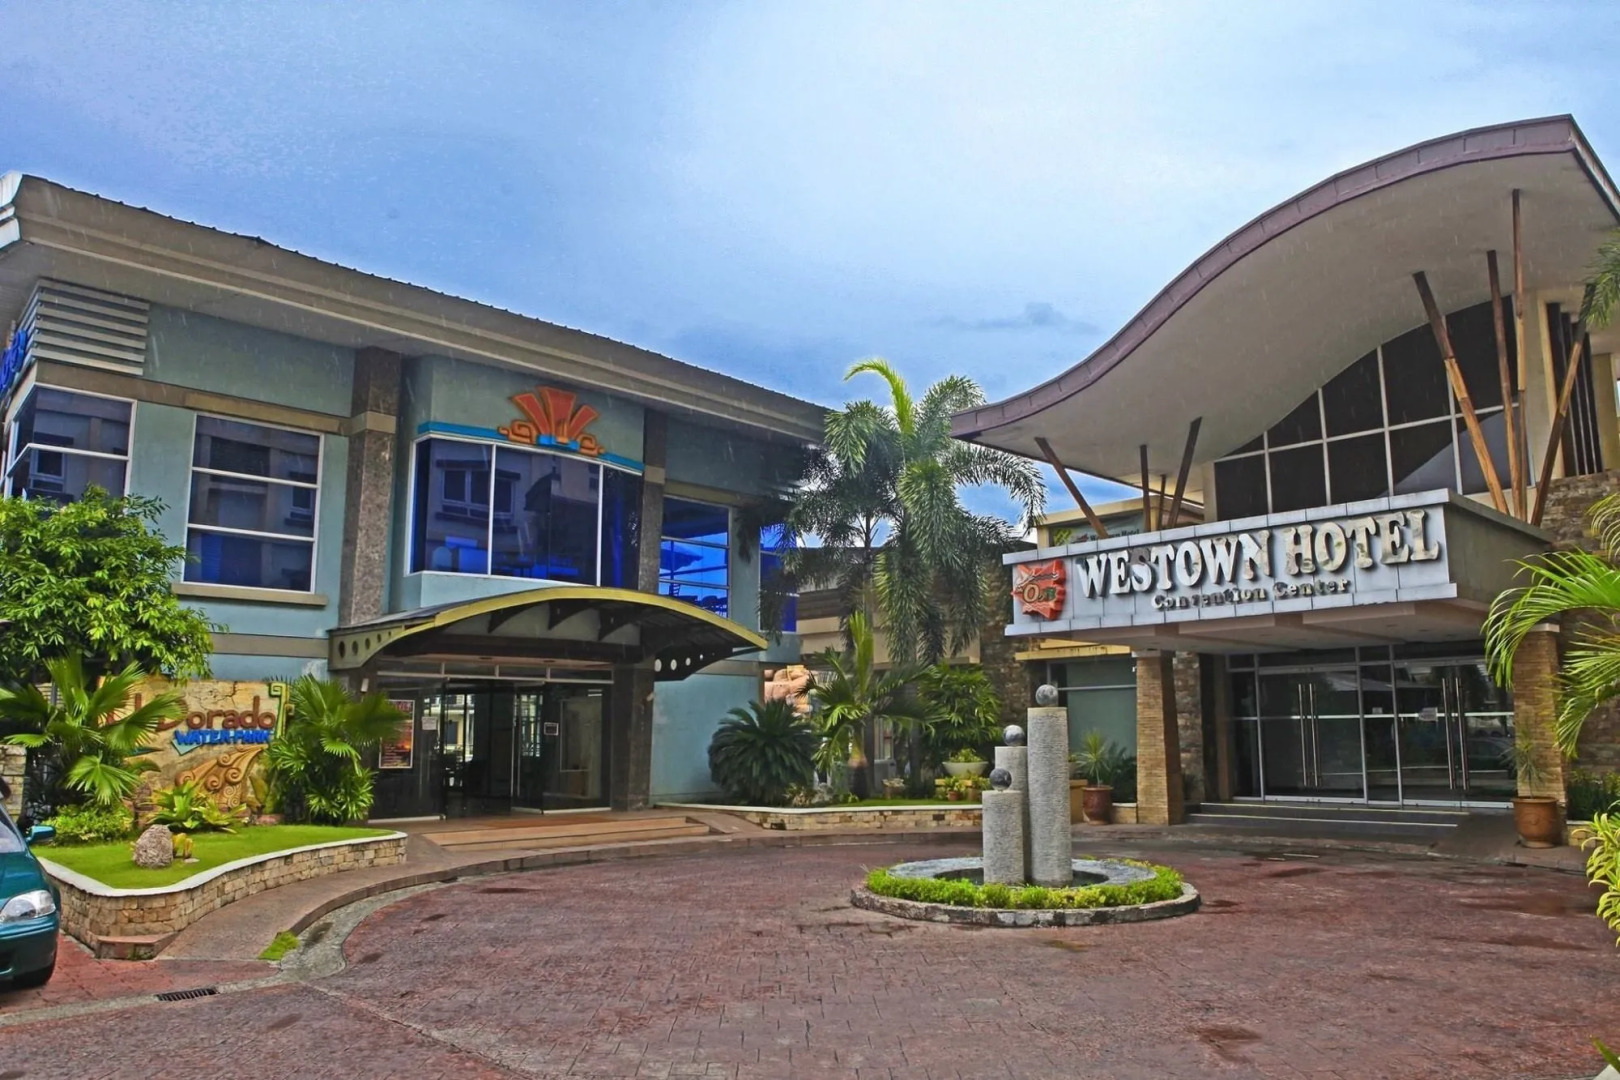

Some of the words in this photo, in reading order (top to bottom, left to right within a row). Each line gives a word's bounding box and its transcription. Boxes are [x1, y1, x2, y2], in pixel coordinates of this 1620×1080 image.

[1076, 529, 1271, 598] WESTOWN
[1285, 509, 1440, 576] HOTEL
[1152, 586, 1267, 611] Convention
[1273, 578, 1350, 598] Center
